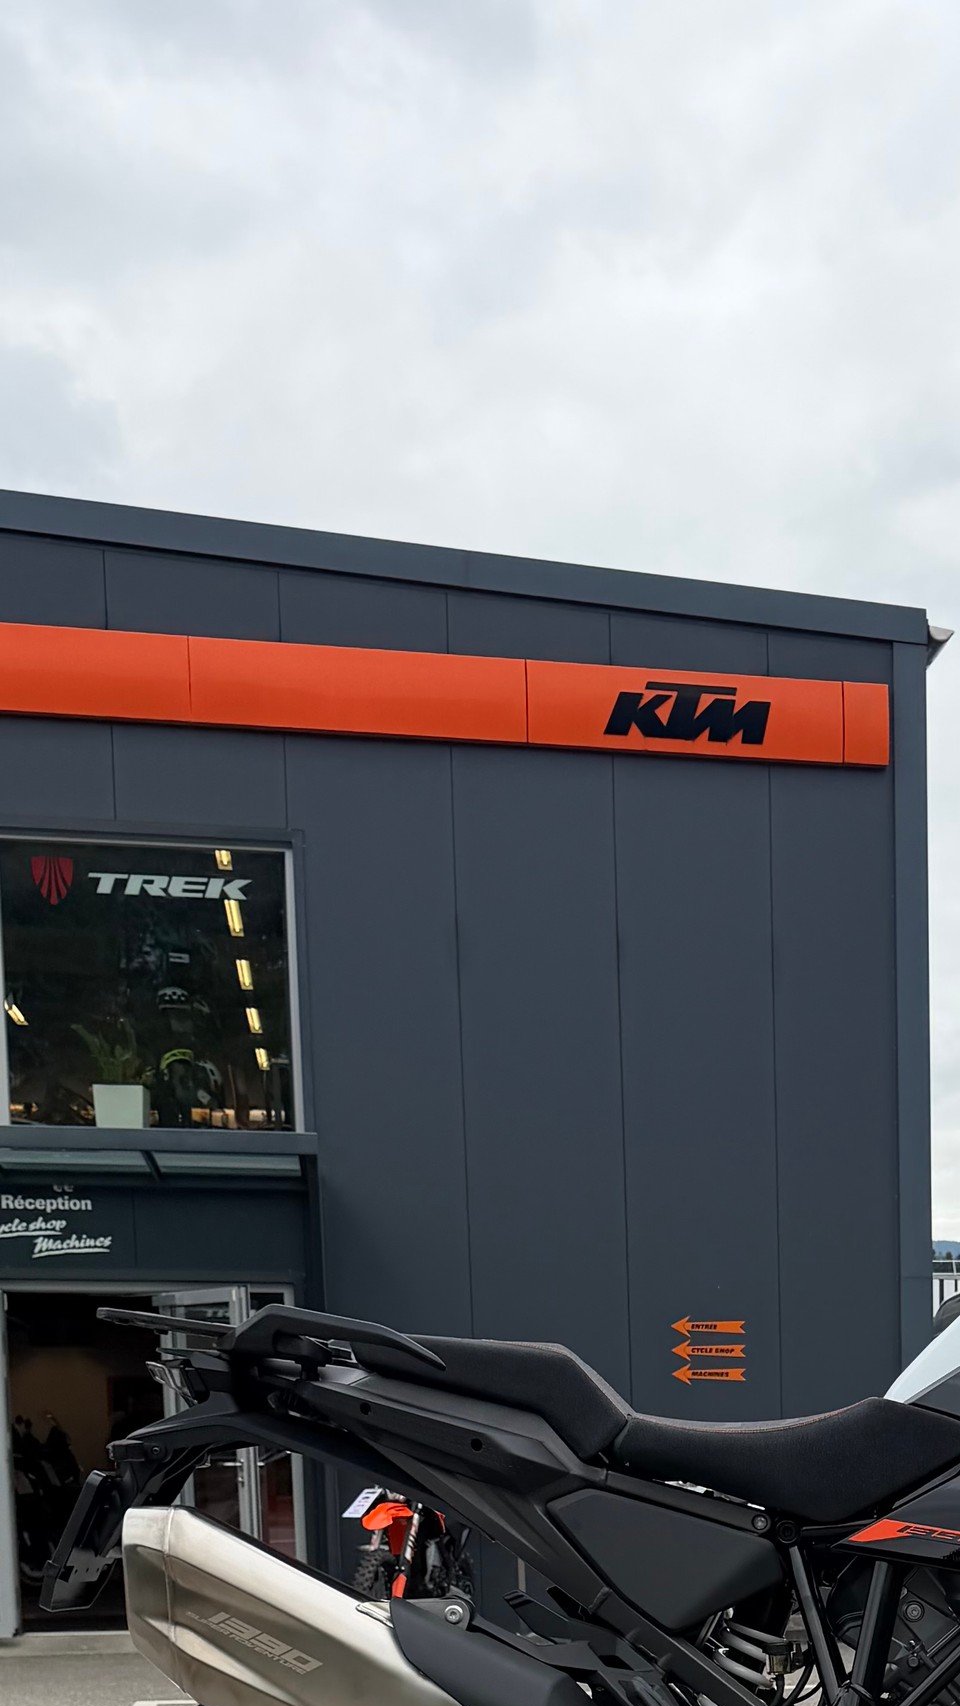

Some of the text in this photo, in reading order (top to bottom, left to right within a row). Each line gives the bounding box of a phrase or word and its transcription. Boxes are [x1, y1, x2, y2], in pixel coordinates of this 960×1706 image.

[603, 681, 771, 745] KTM
[88, 872, 253, 900] TREK
[0, 1194, 92, 1213] Réception
[28, 1216, 67, 1231] shop
[33, 1234, 112, 1254] Machines
